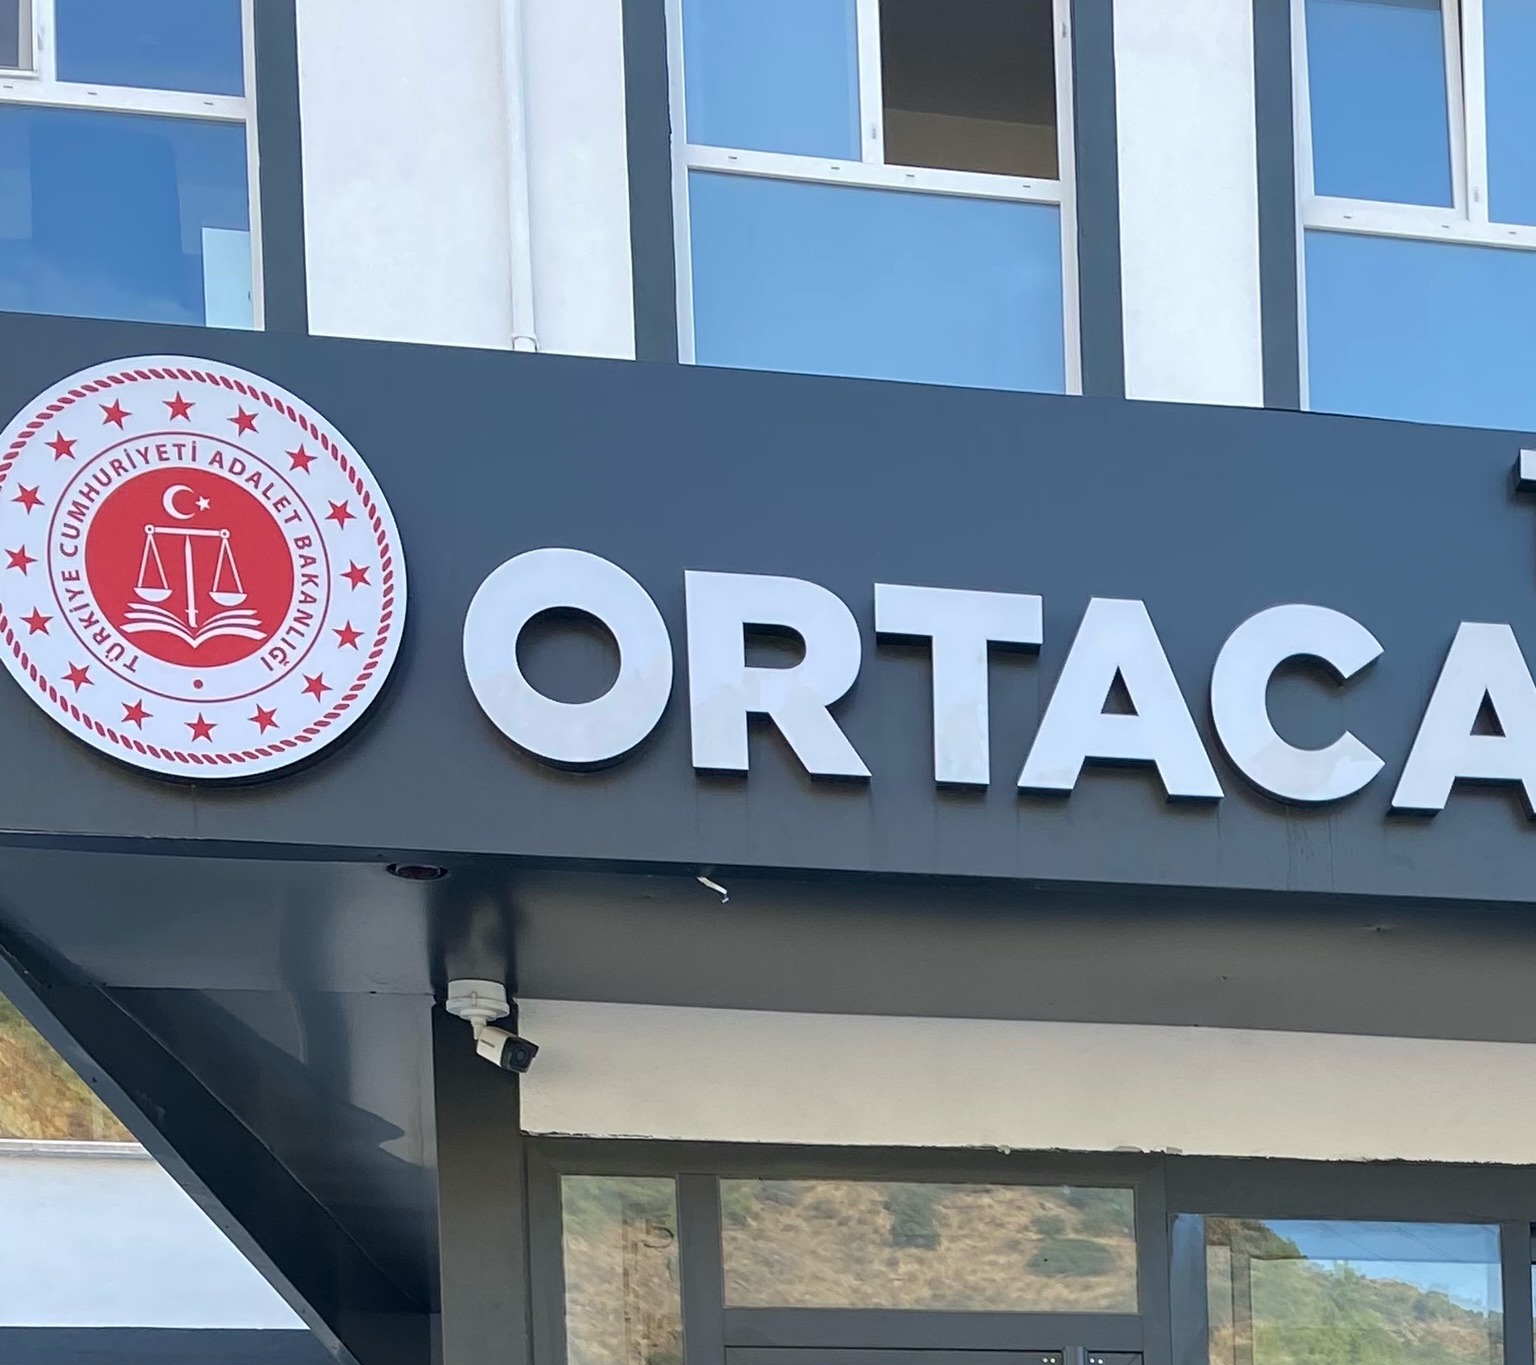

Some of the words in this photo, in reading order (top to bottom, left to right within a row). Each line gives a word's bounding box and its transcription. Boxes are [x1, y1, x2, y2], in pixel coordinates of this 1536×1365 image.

[59, 440, 198, 558] CUMHURİYETİ
[208, 450, 303, 524] ADALET
[61, 569, 139, 673] TÜRKİYE
[260, 535, 319, 672] BAKANLIĞI
